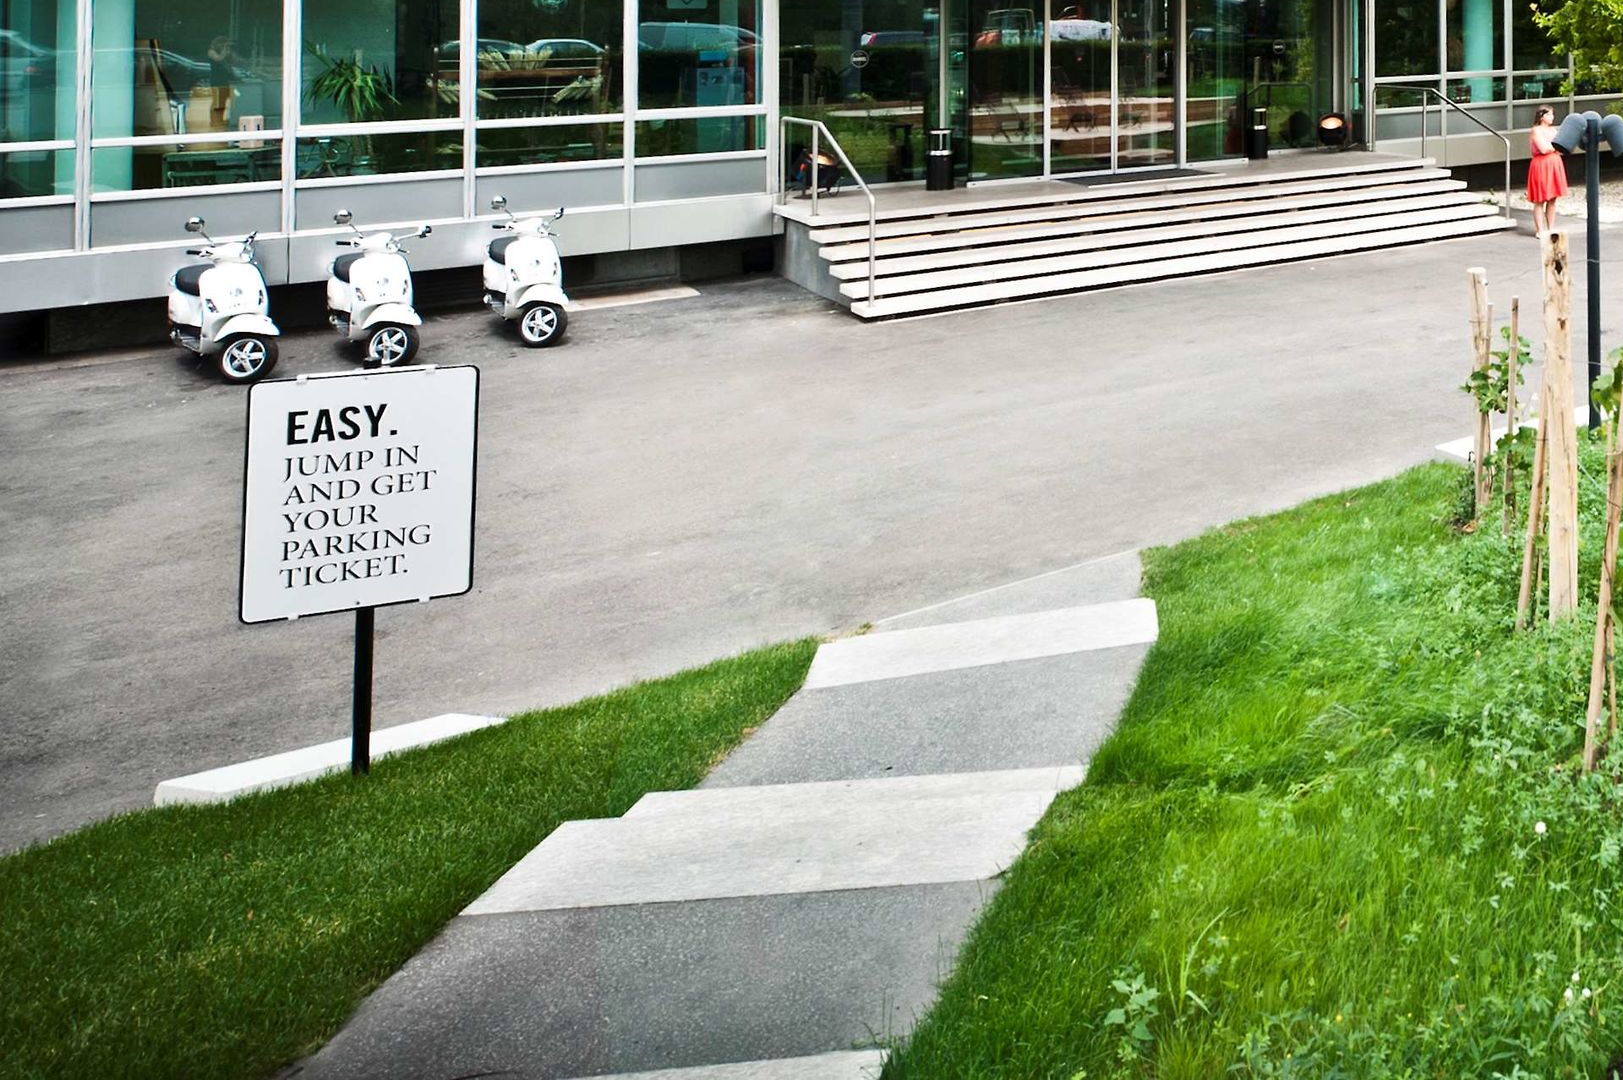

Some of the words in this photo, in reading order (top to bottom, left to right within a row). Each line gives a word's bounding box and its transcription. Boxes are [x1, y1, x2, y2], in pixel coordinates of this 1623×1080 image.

[287, 403, 398, 445] EASY.
[284, 450, 374, 482] JUMP
[384, 445, 420, 467] IN
[283, 479, 361, 506] AND
[371, 470, 437, 496] GET
[283, 504, 378, 533] YOUR
[281, 524, 431, 562] PARKING
[279, 554, 408, 589] TICKET.
